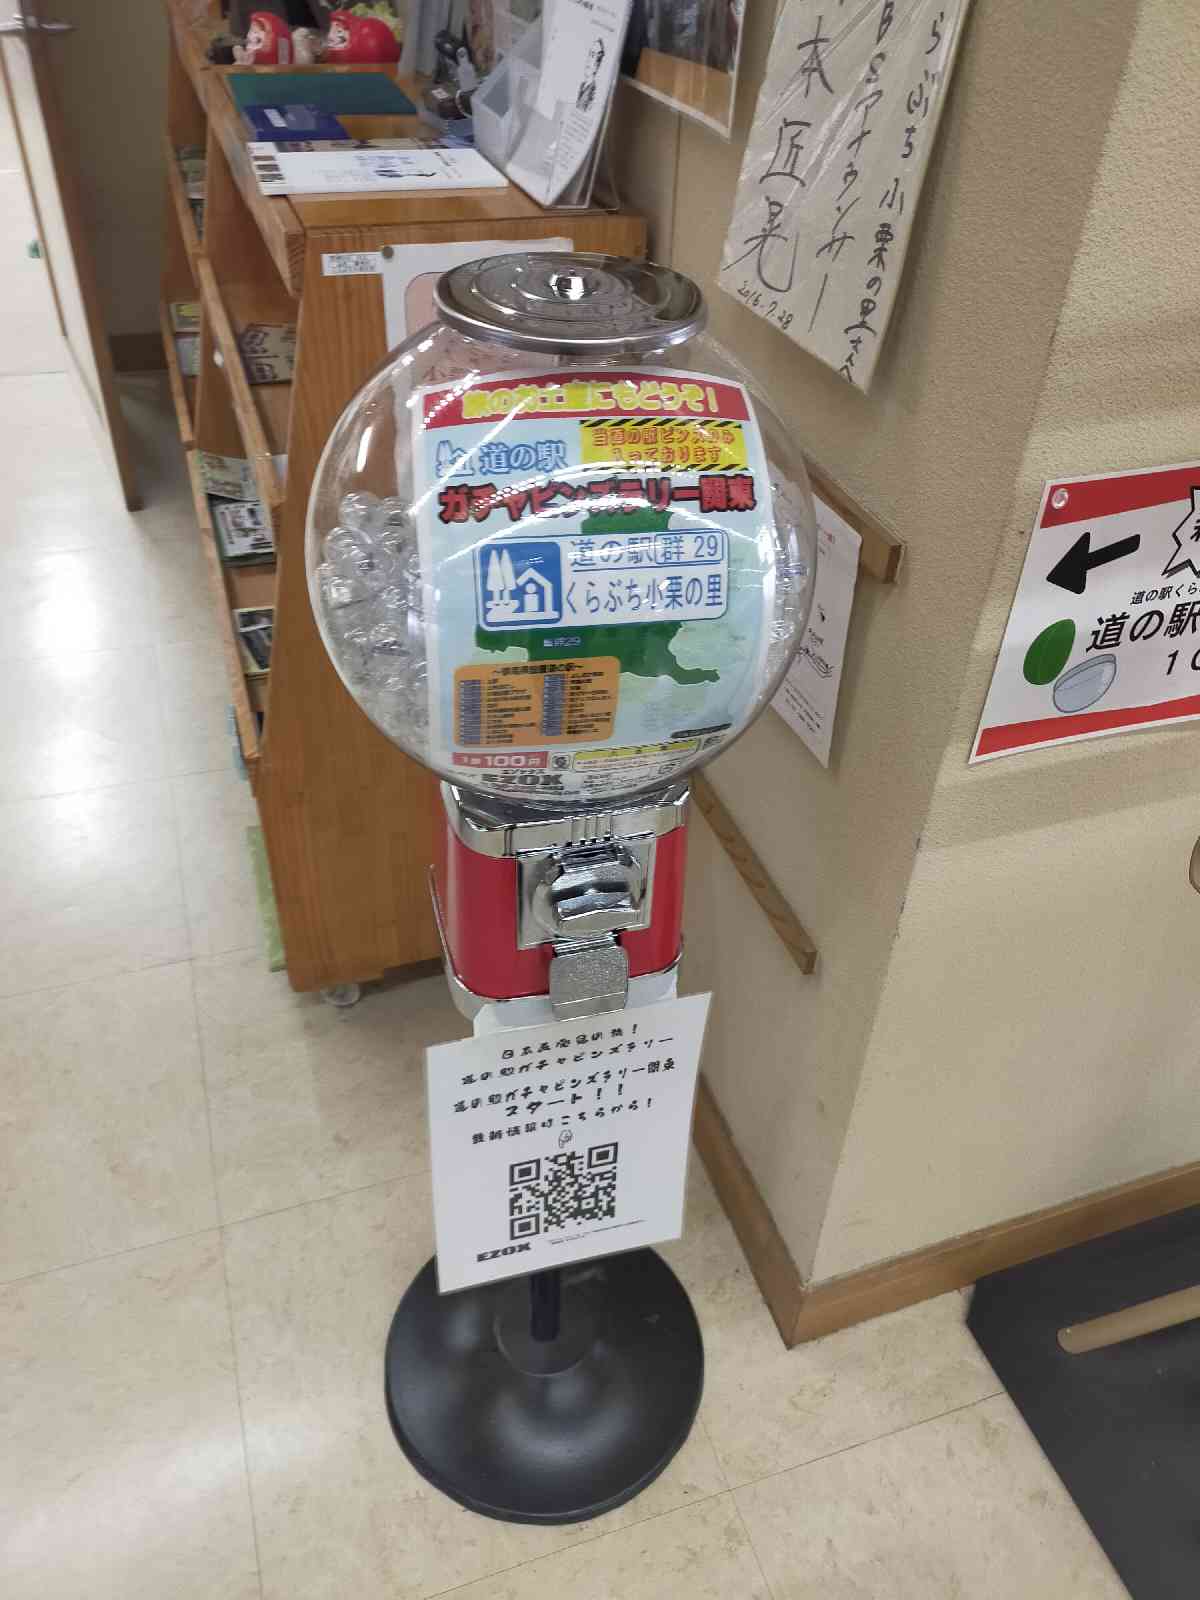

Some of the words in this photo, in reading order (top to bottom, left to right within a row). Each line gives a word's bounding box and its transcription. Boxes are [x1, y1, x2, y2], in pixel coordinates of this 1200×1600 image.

[723, 0, 843, 293] 本匠晃
[480, 439, 569, 476] 道の駅
[569, 535, 653, 567] 道の駅
[661, 535, 685, 562] 群
[693, 534, 719, 558] 29
[1130, 582, 1200, 606] 道の駅くら
[475, 1242, 532, 1263] EZOX
